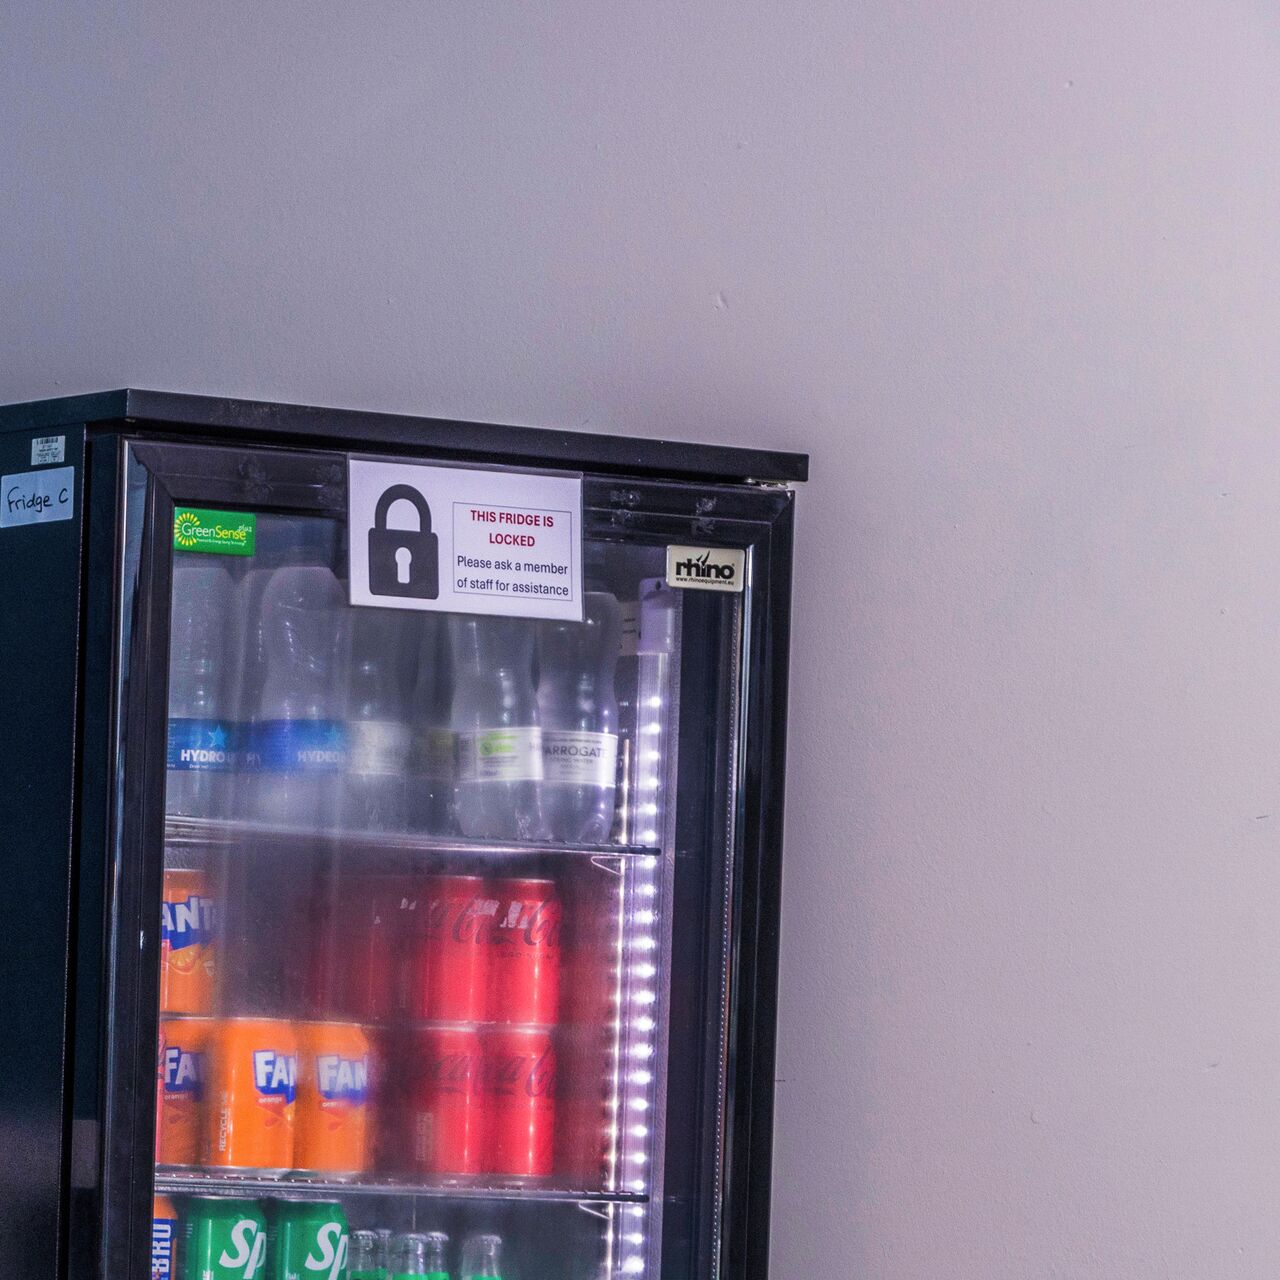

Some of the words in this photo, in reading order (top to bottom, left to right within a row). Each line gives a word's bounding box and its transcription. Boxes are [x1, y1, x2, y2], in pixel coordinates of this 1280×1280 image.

[7, 486, 52, 513] Fridge
[58, 488, 69, 504] C
[470, 509, 496, 523] THIS
[499, 512, 541, 527] FRIDGE
[543, 516, 554, 527] IS
[181, 522, 246, 541] GreenSense
[488, 532, 535, 547] LOCKED
[457, 555, 492, 569] Please
[494, 559, 512, 571] ask
[515, 561, 521, 571] a
[524, 562, 568, 575] member
[676, 552, 735, 579] rhino
[457, 577, 468, 588] of
[470, 578, 493, 590] staff
[495, 579, 510, 591] for
[512, 582, 569, 596] assistance
